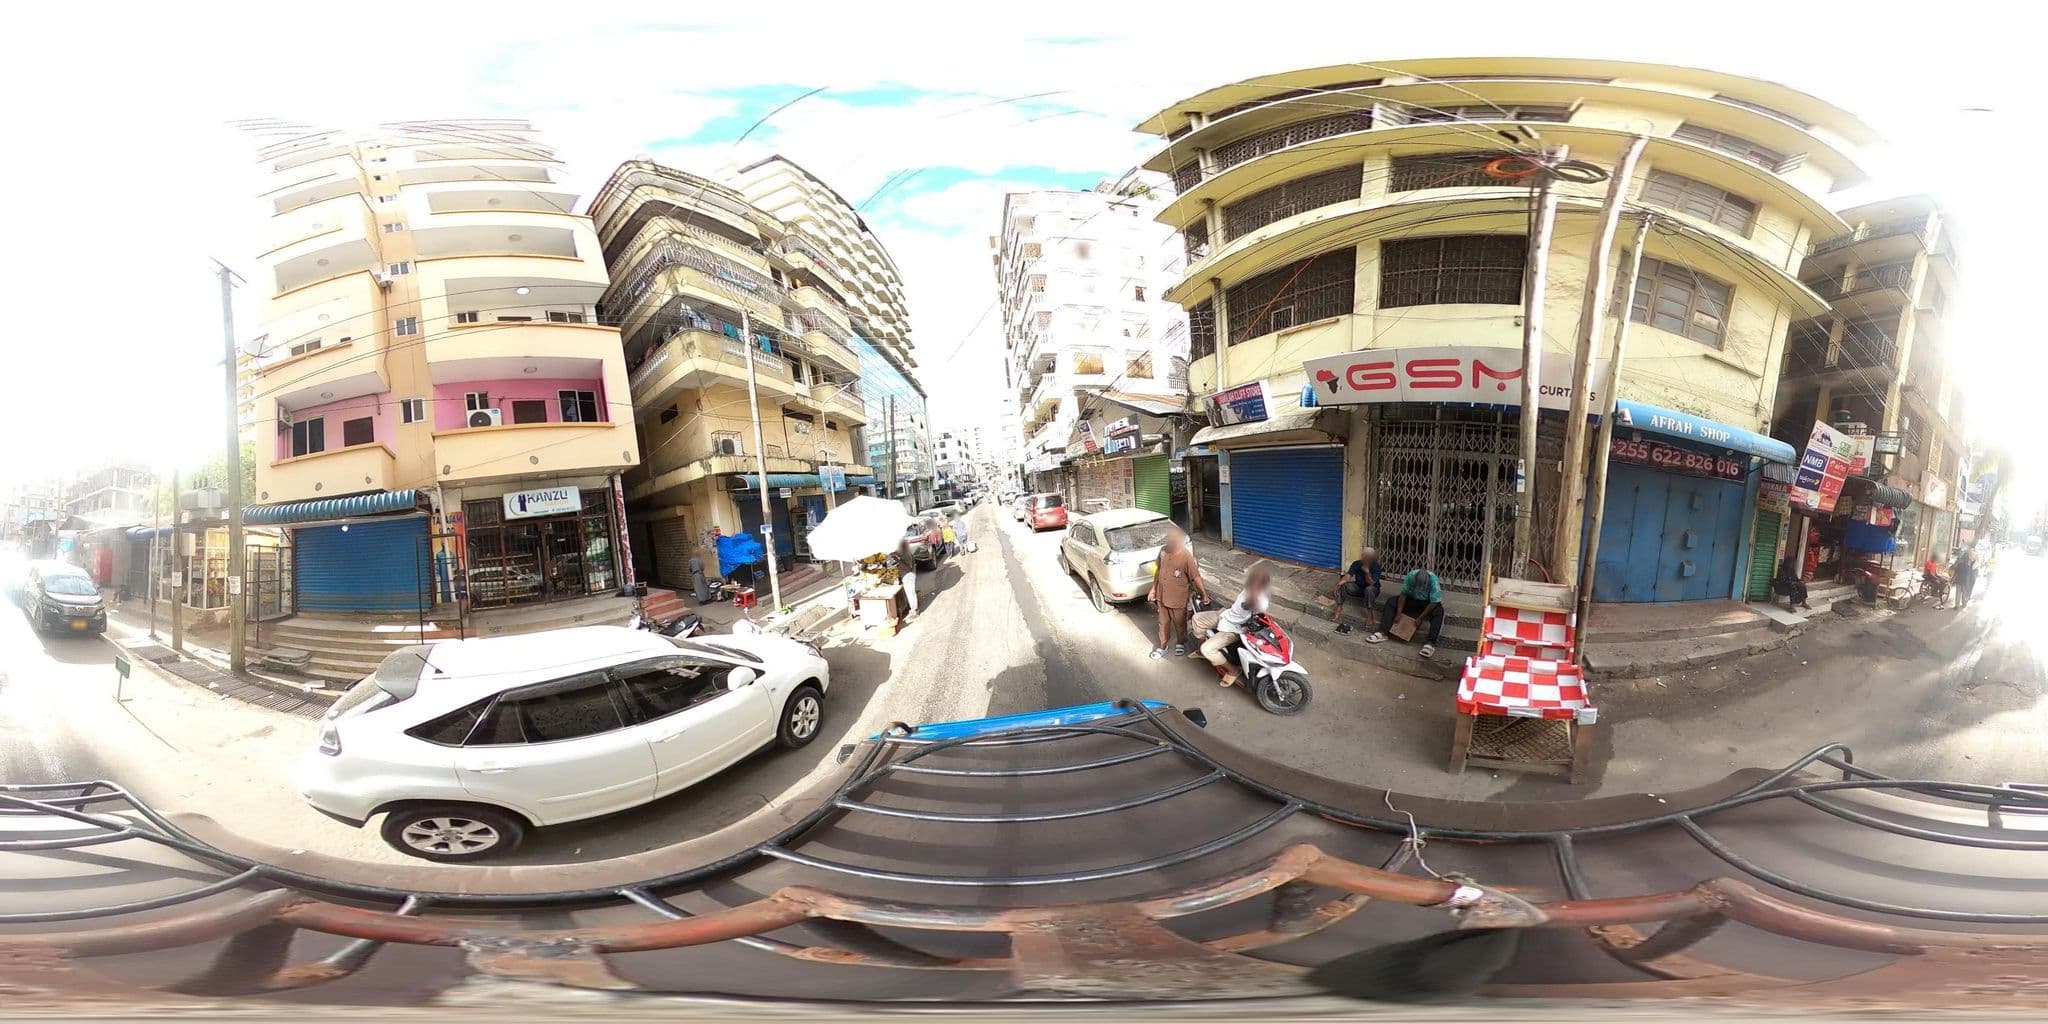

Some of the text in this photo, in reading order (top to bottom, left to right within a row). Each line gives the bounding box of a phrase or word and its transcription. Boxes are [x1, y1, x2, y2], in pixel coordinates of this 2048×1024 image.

[1346, 358, 1523, 391] GSM
[1540, 385, 1596, 401] CURTS
[1650, 415, 1730, 443] AFRAH SHOP
[1652, 447, 1682, 466] 622
[1686, 454, 1713, 471] 826
[1717, 460, 1739, 476] 016
[1803, 454, 1824, 468] NMB
[527, 490, 568, 504] KANZU
